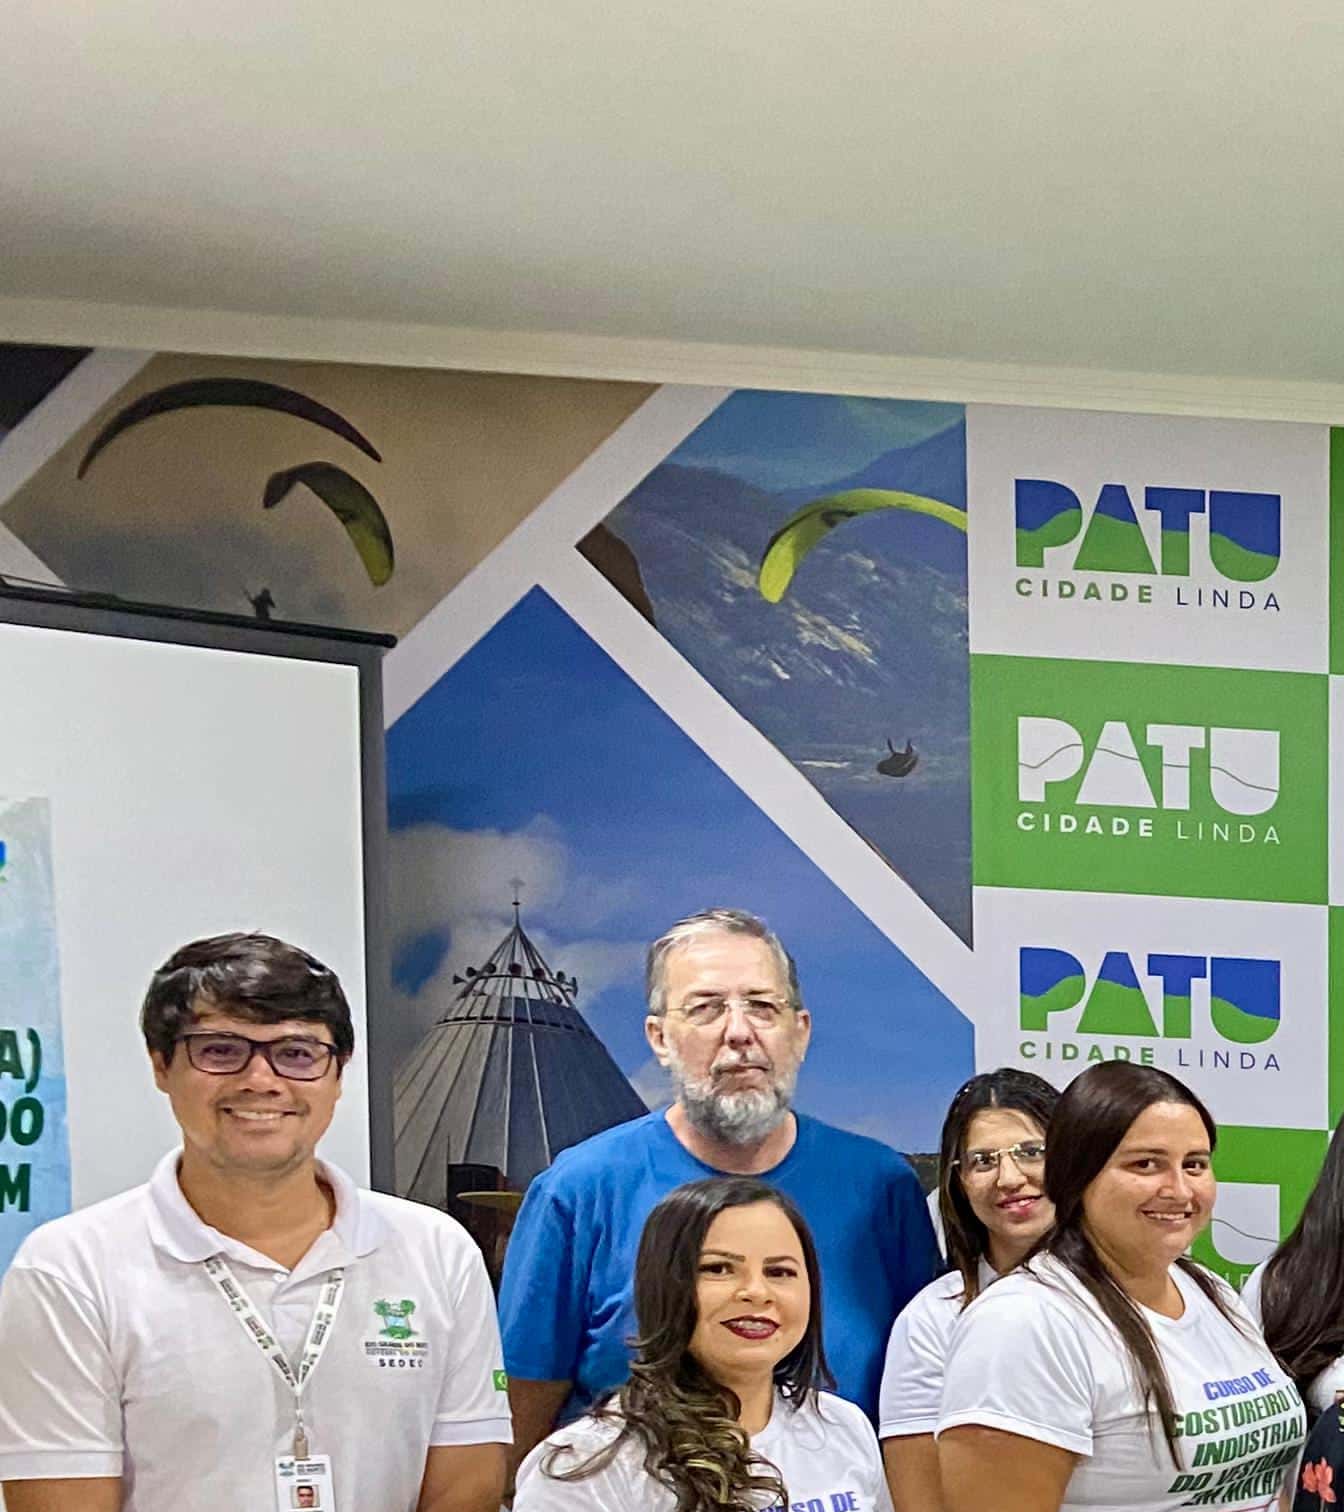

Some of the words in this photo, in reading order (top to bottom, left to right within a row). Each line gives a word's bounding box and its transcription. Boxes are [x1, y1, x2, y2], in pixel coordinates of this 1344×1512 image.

[1015, 478, 1281, 583] PATU
[1015, 577, 1154, 604] CIDADE
[1175, 586, 1281, 612] LINDA
[1017, 715, 1280, 816] PATU
[1016, 811, 1154, 838] CIDADE
[1176, 820, 1280, 845] LINDA
[1019, 946, 1281, 1045] PATU
[1019, 1040, 1156, 1066] CIDADE
[1177, 1047, 1281, 1072] LINDA
[1203, 1376, 1257, 1401] CURSO
[1252, 1367, 1276, 1389] DE
[1191, 1415, 1304, 1468] INDUSTRIAL
[1168, 1471, 1213, 1494] DO
